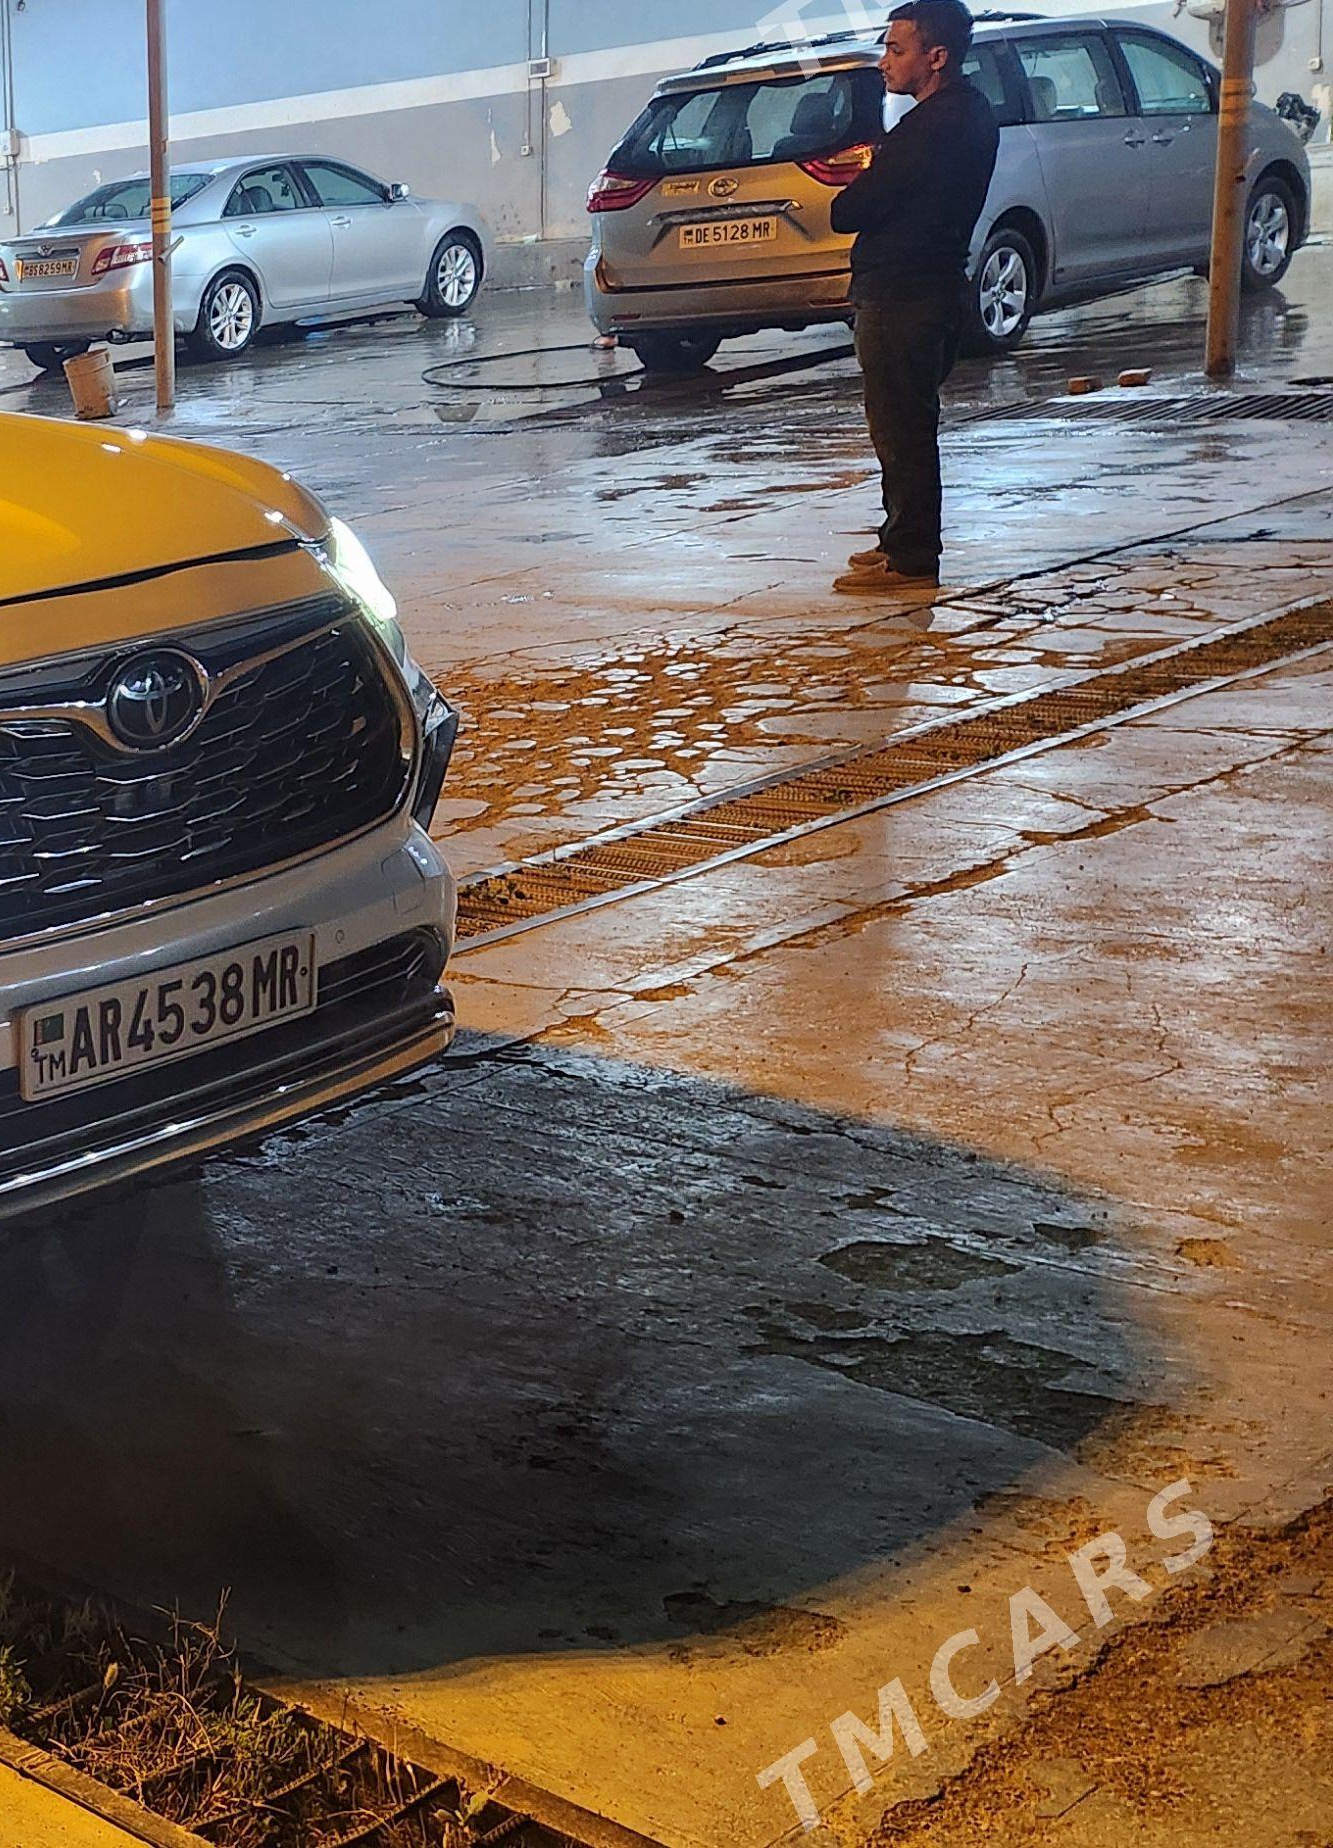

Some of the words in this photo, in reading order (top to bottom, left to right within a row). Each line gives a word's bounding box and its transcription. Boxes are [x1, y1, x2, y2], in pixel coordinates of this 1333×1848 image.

[695, 227, 710, 244] DE
[713, 224, 750, 242] 5128
[753, 221, 770, 239] MR
[35, 1049, 66, 1084] TM
